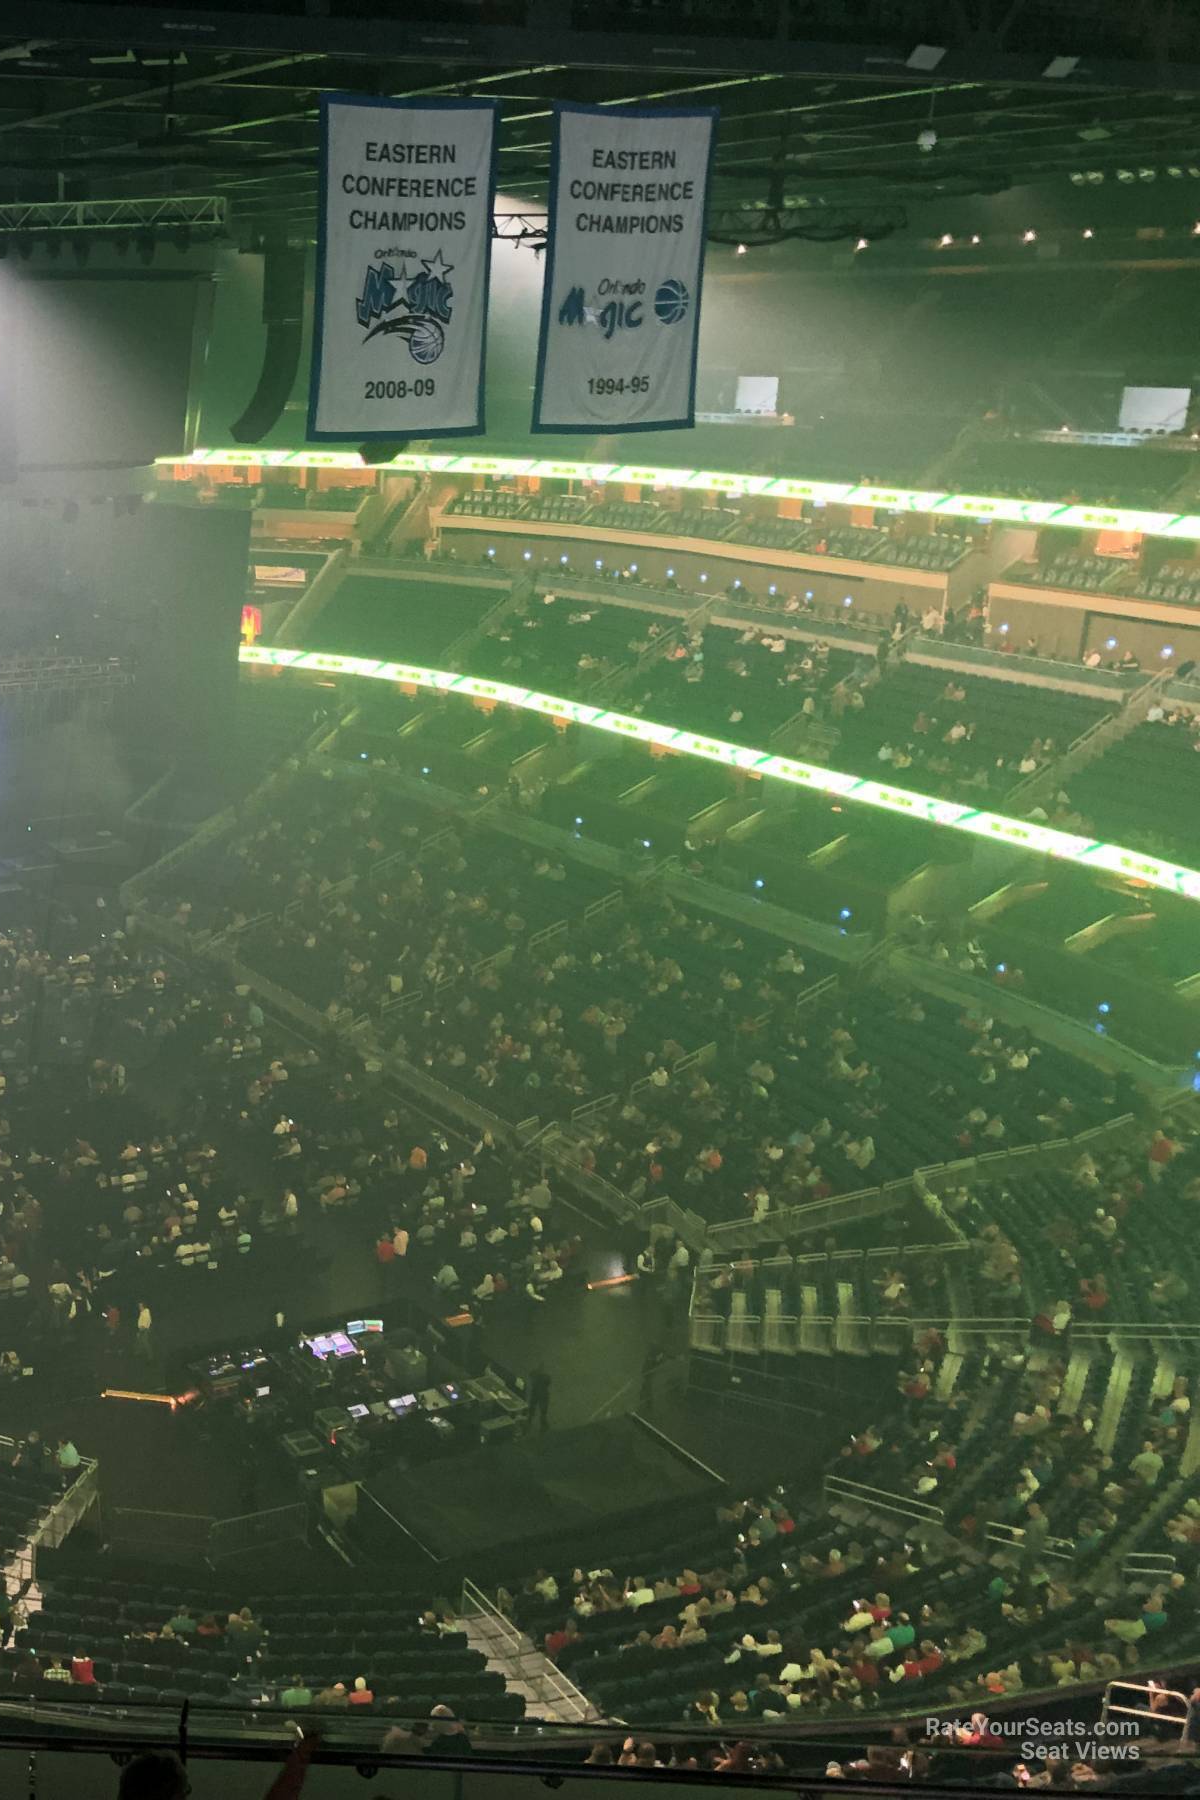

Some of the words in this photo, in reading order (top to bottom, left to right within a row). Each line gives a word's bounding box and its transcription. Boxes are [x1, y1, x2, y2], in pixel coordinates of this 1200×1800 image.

[365, 142, 457, 164] EASTERN
[592, 149, 676, 170] EASTERN
[342, 174, 477, 198] CONFERENCE
[569, 179, 694, 202] CONFERENCE
[350, 210, 466, 231] CHAMPIONS
[575, 213, 684, 234] CHAMPIONS
[364, 378, 435, 399] 2008-09
[587, 376, 649, 395] 1994-95
